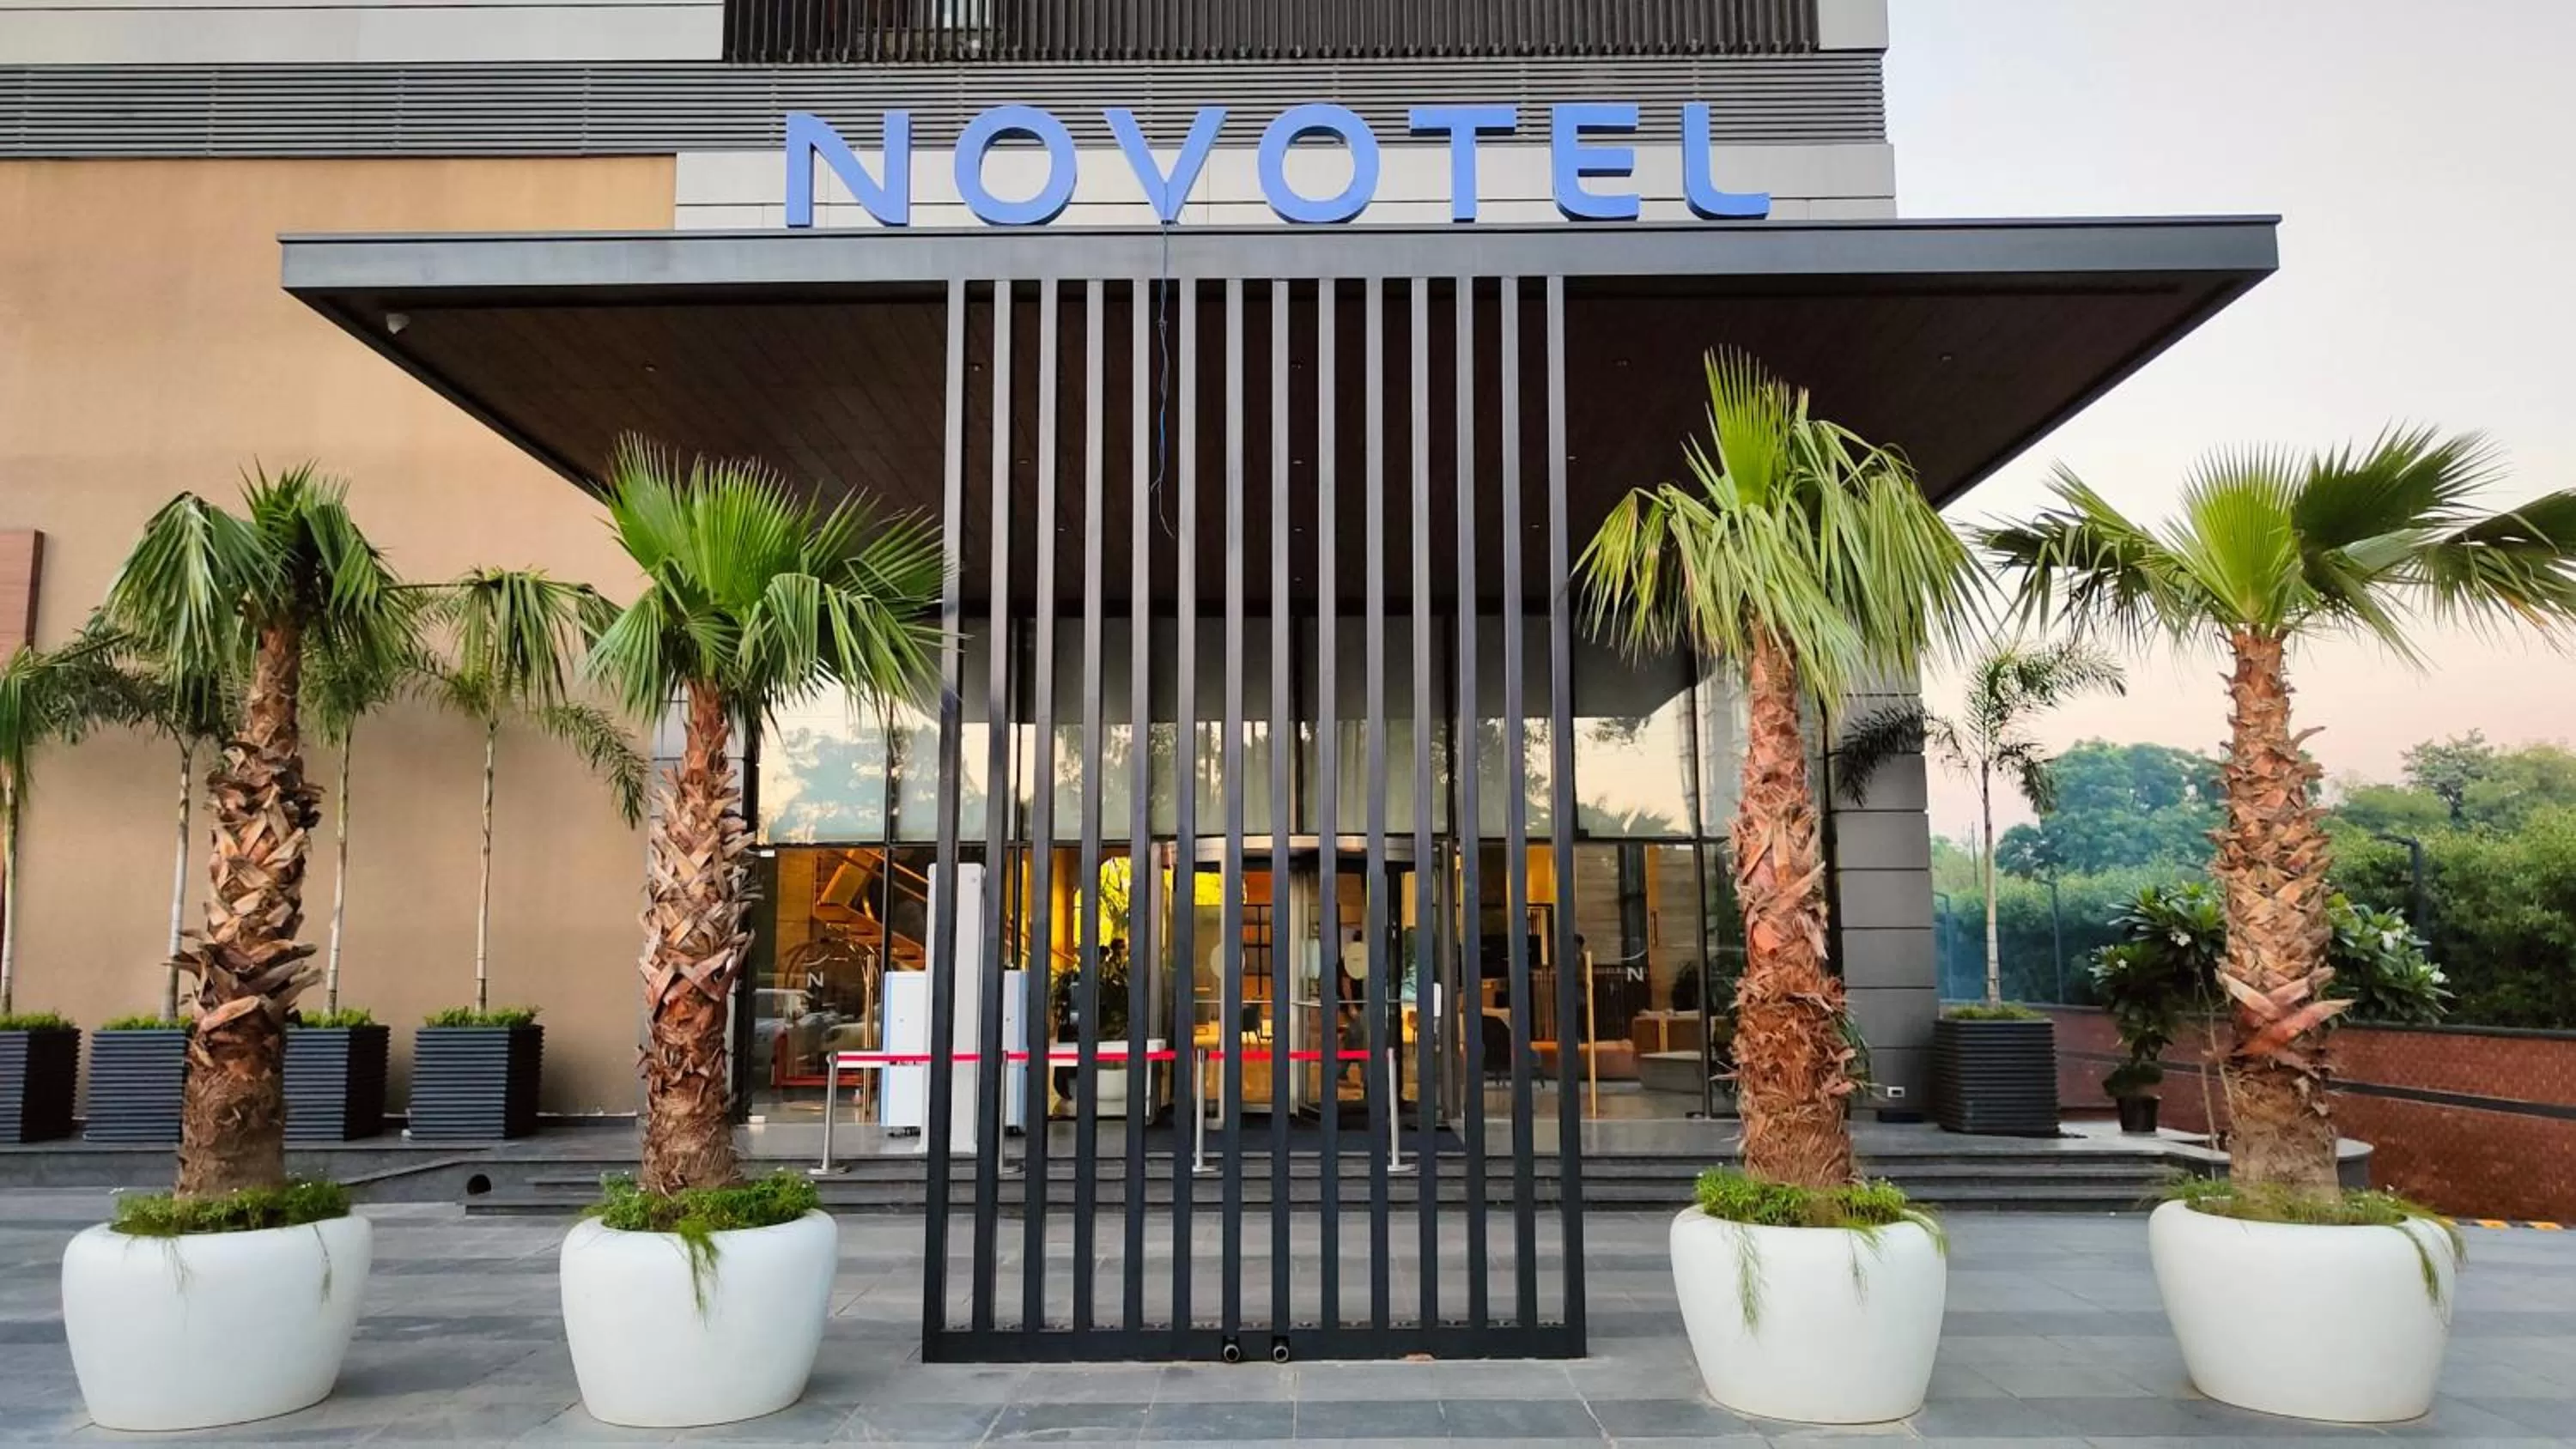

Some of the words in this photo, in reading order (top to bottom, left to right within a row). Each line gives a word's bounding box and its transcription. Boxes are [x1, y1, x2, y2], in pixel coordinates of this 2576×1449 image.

[785, 101, 1771, 229] NOVOTEL
[807, 971, 824, 988] N
[1627, 966, 1644, 983] N
